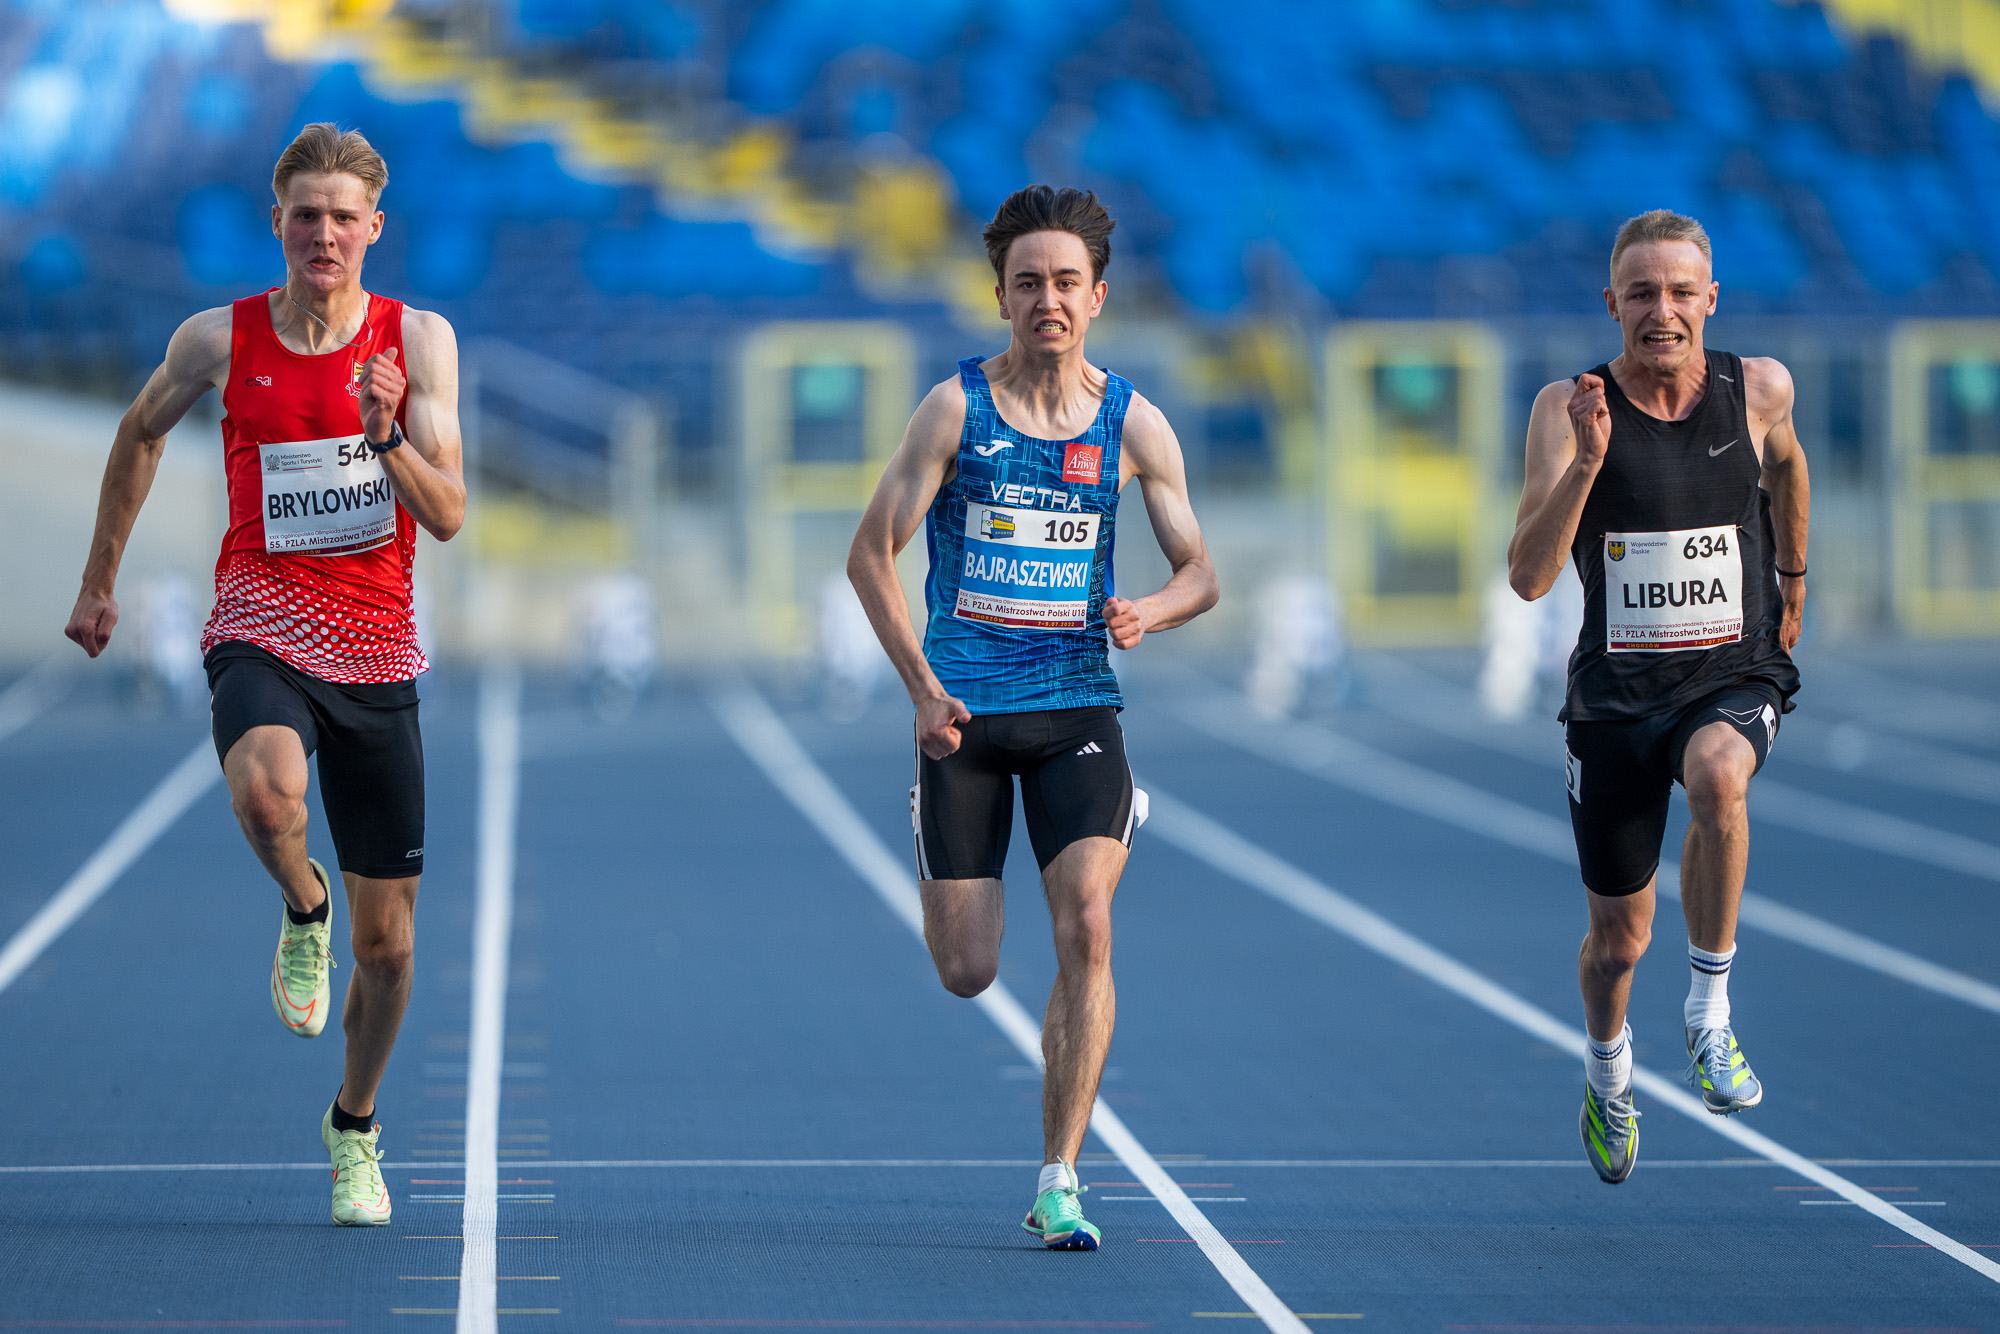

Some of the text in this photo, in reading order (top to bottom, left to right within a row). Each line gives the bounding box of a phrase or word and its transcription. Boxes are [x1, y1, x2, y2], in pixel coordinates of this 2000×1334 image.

[301, 457, 323, 465] Turystyki
[1067, 453, 1098, 470] Anwil
[268, 477, 391, 520] BRYLOWSKI
[990, 481, 1082, 512] VECTRA
[270, 520, 395, 549] 55. PZLA Mistrzostwa Polski U18
[1044, 519, 1089, 543] 105
[1683, 533, 1728, 560] 634
[964, 551, 1089, 588] BAJRASZEWSKI
[969, 593, 1002, 603] Ogólnopolska
[1623, 577, 1728, 608] LIBURA
[958, 597, 1086, 617] 55. PZLA Mistrzostwa Polski U18
[971, 613, 1005, 623] CHORZÓW
[1610, 623, 1741, 638] 55. PZLA Mistrzostwa Polski U18
